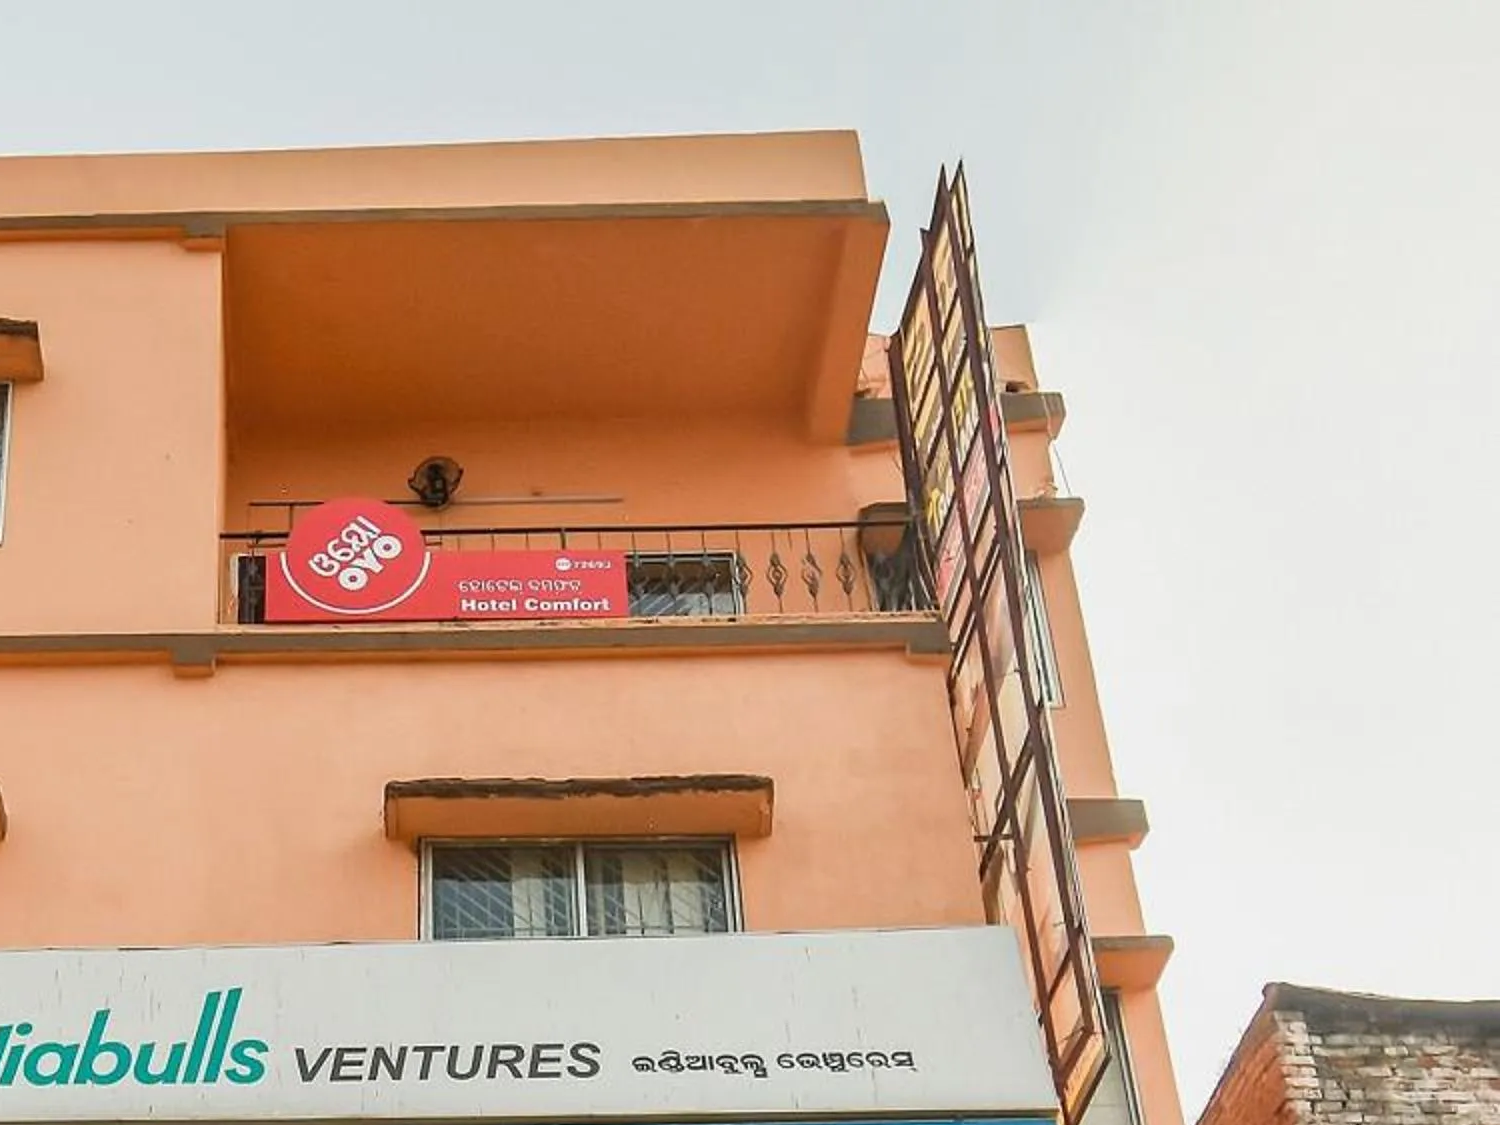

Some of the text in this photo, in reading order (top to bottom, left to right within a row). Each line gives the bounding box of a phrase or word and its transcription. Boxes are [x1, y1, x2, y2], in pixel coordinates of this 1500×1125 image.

[338, 535, 403, 590] OYO
[460, 597, 611, 612] Hotel Comfort
[294, 1042, 602, 1082] VENTURES
